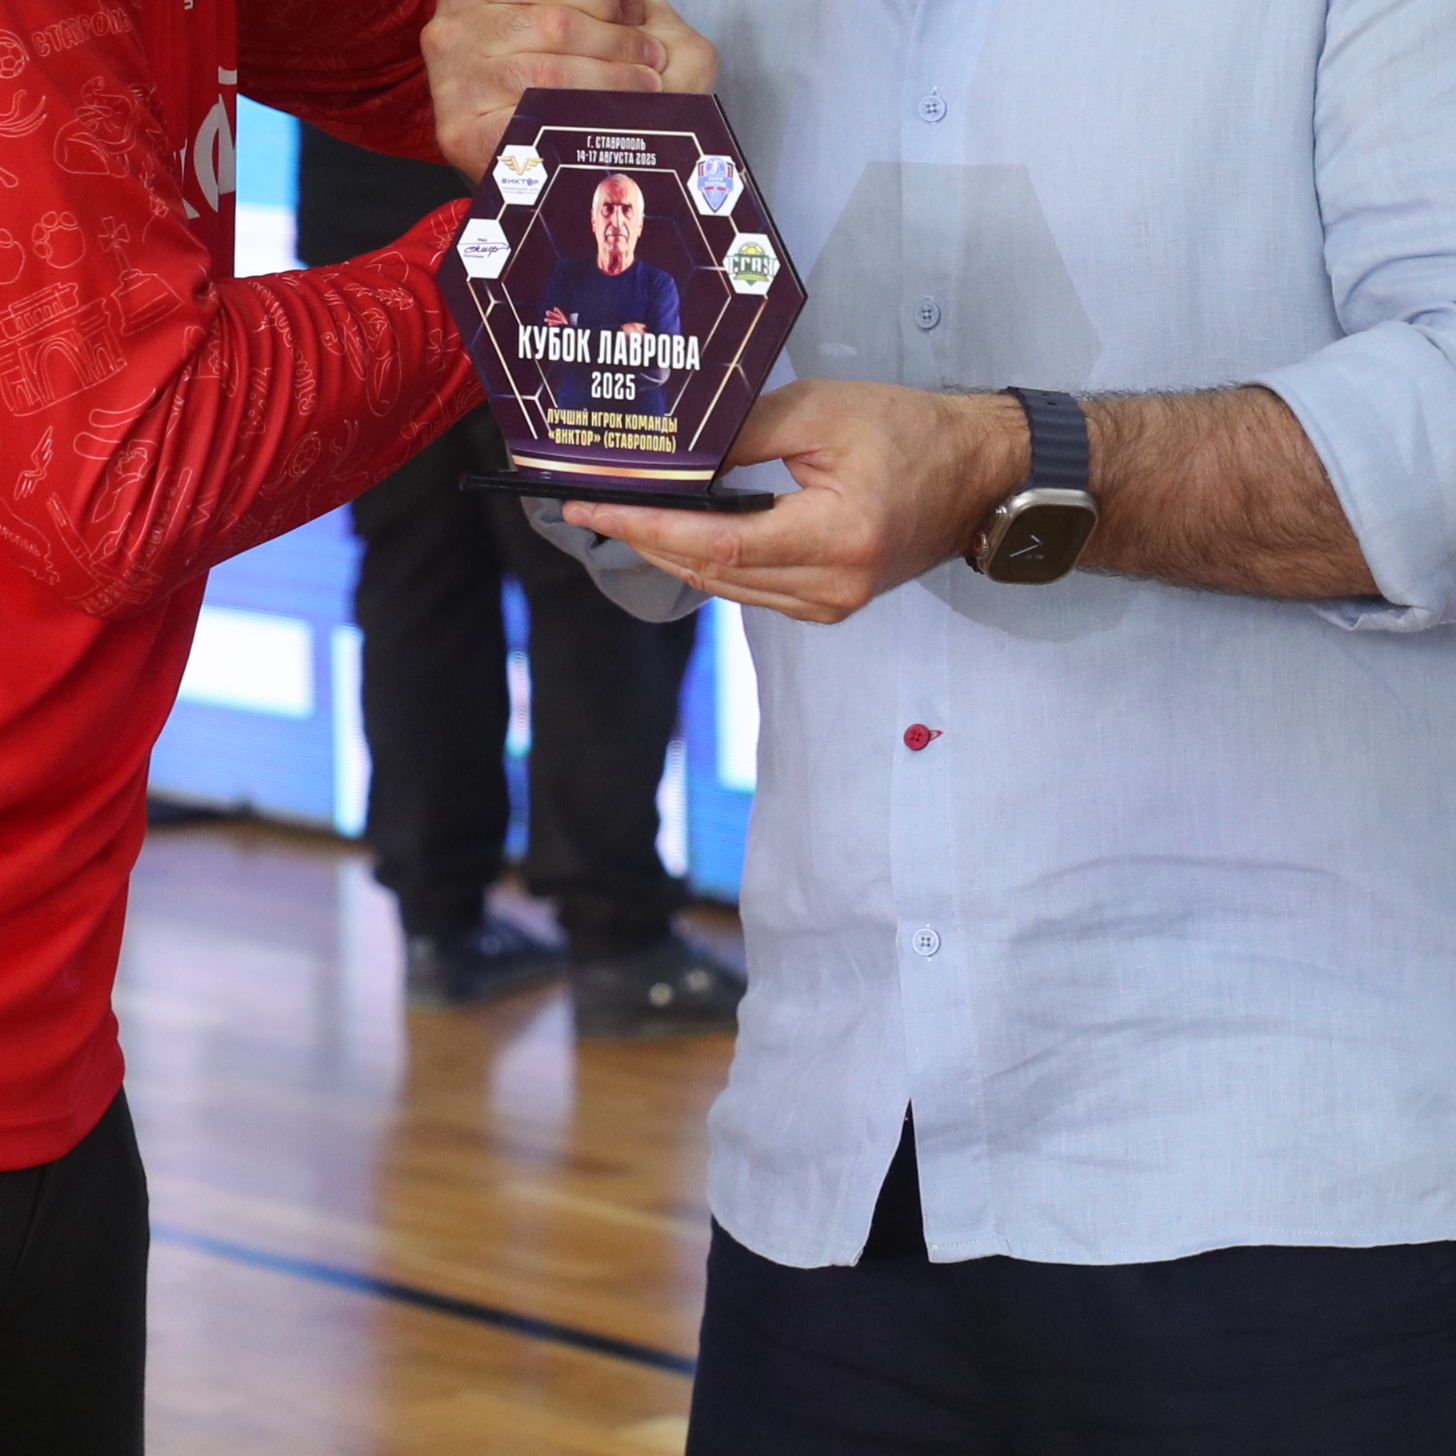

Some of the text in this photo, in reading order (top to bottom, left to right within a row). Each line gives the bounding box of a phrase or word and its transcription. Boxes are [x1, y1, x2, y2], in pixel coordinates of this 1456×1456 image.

[587, 136, 646, 150] Г. СТАВРОПОЛЬ
[576, 150, 656, 165] 14-17 АВГУСТА 2025
[501, 178, 539, 186] ВИКТОР
[518, 324, 701, 370] КУБОК ЛАВРОВА
[591, 371, 636, 400] 2025
[547, 408, 678, 434] ЛУЧШИЙ ИГРОК КОМАНДЫ
[548, 428, 677, 454] «ВИКТОР» (СТАВРОПОЛЬ)
